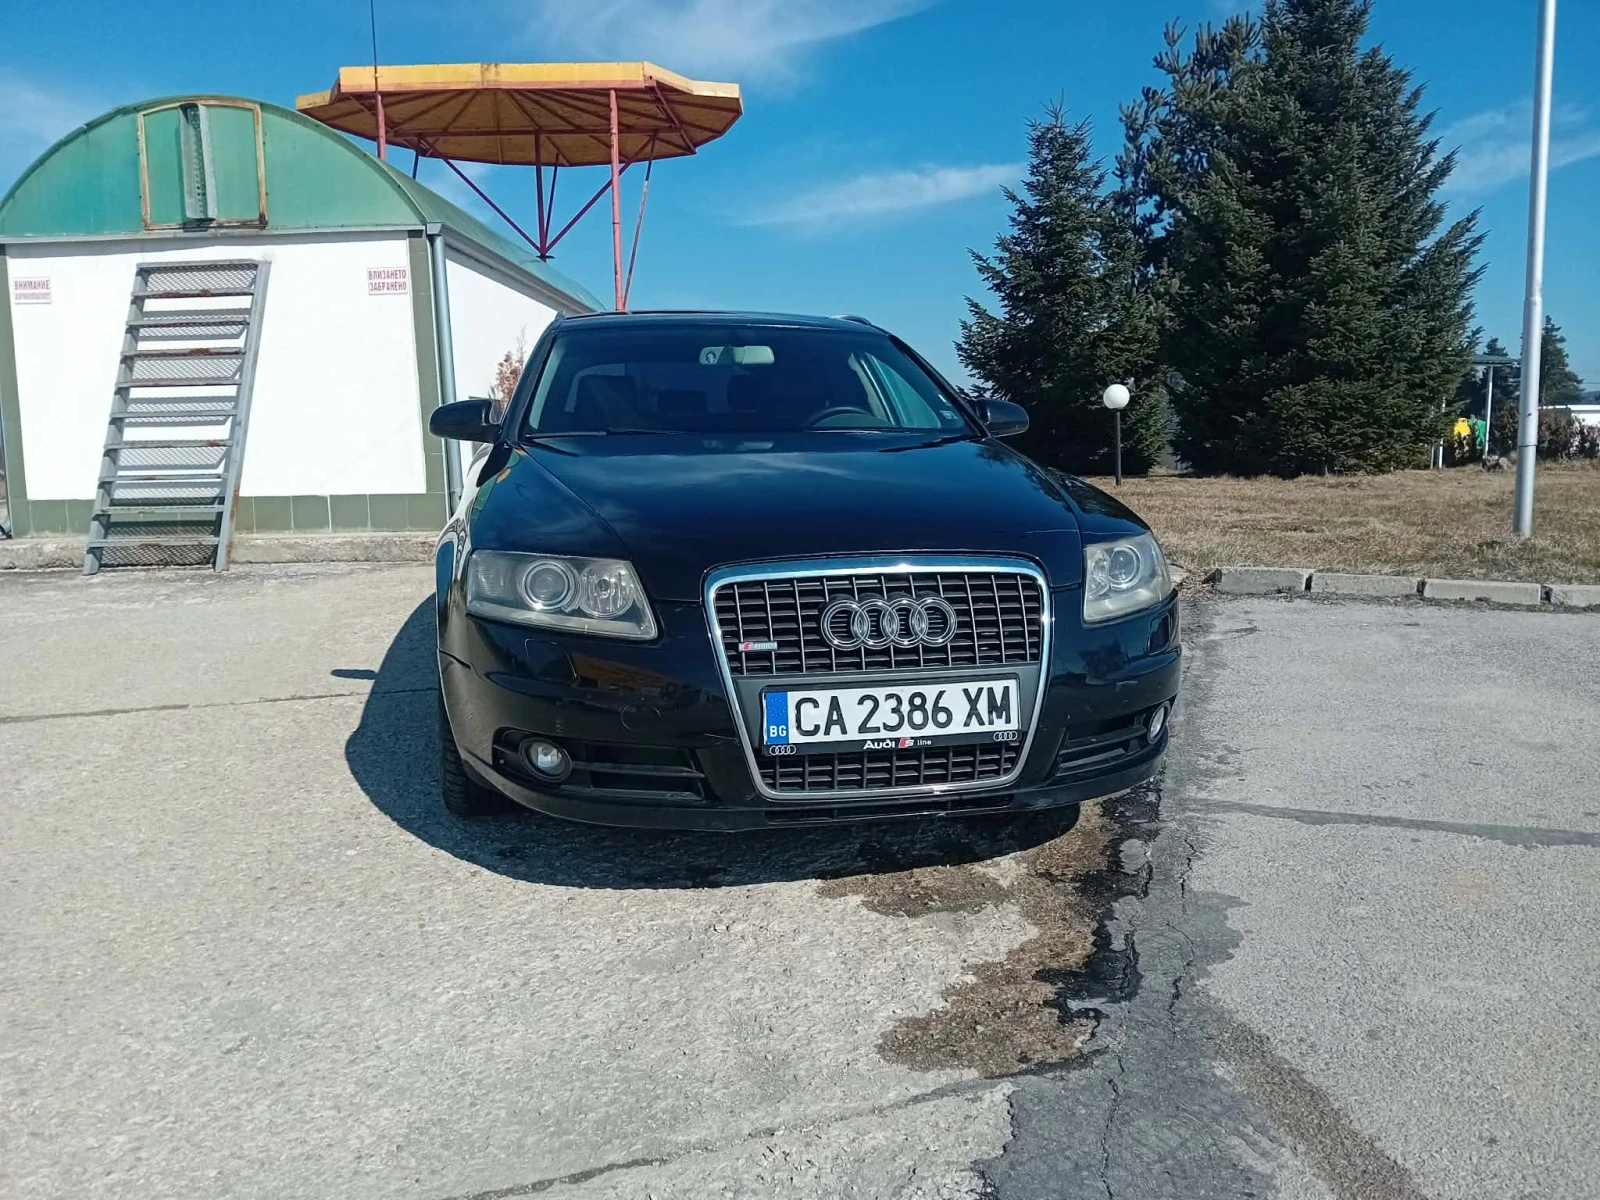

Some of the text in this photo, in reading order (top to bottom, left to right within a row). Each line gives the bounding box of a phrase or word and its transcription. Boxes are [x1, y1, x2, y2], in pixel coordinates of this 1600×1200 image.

[368, 269, 407, 280] ВЛИЗАНЕТО
[14, 280, 51, 290] ВНИМАНИЕ
[369, 281, 407, 291] ЗАБРАНЕНО
[857, 690, 953, 734] 2386
[769, 726, 787, 737] BG
[862, 740, 896, 750] Audi
